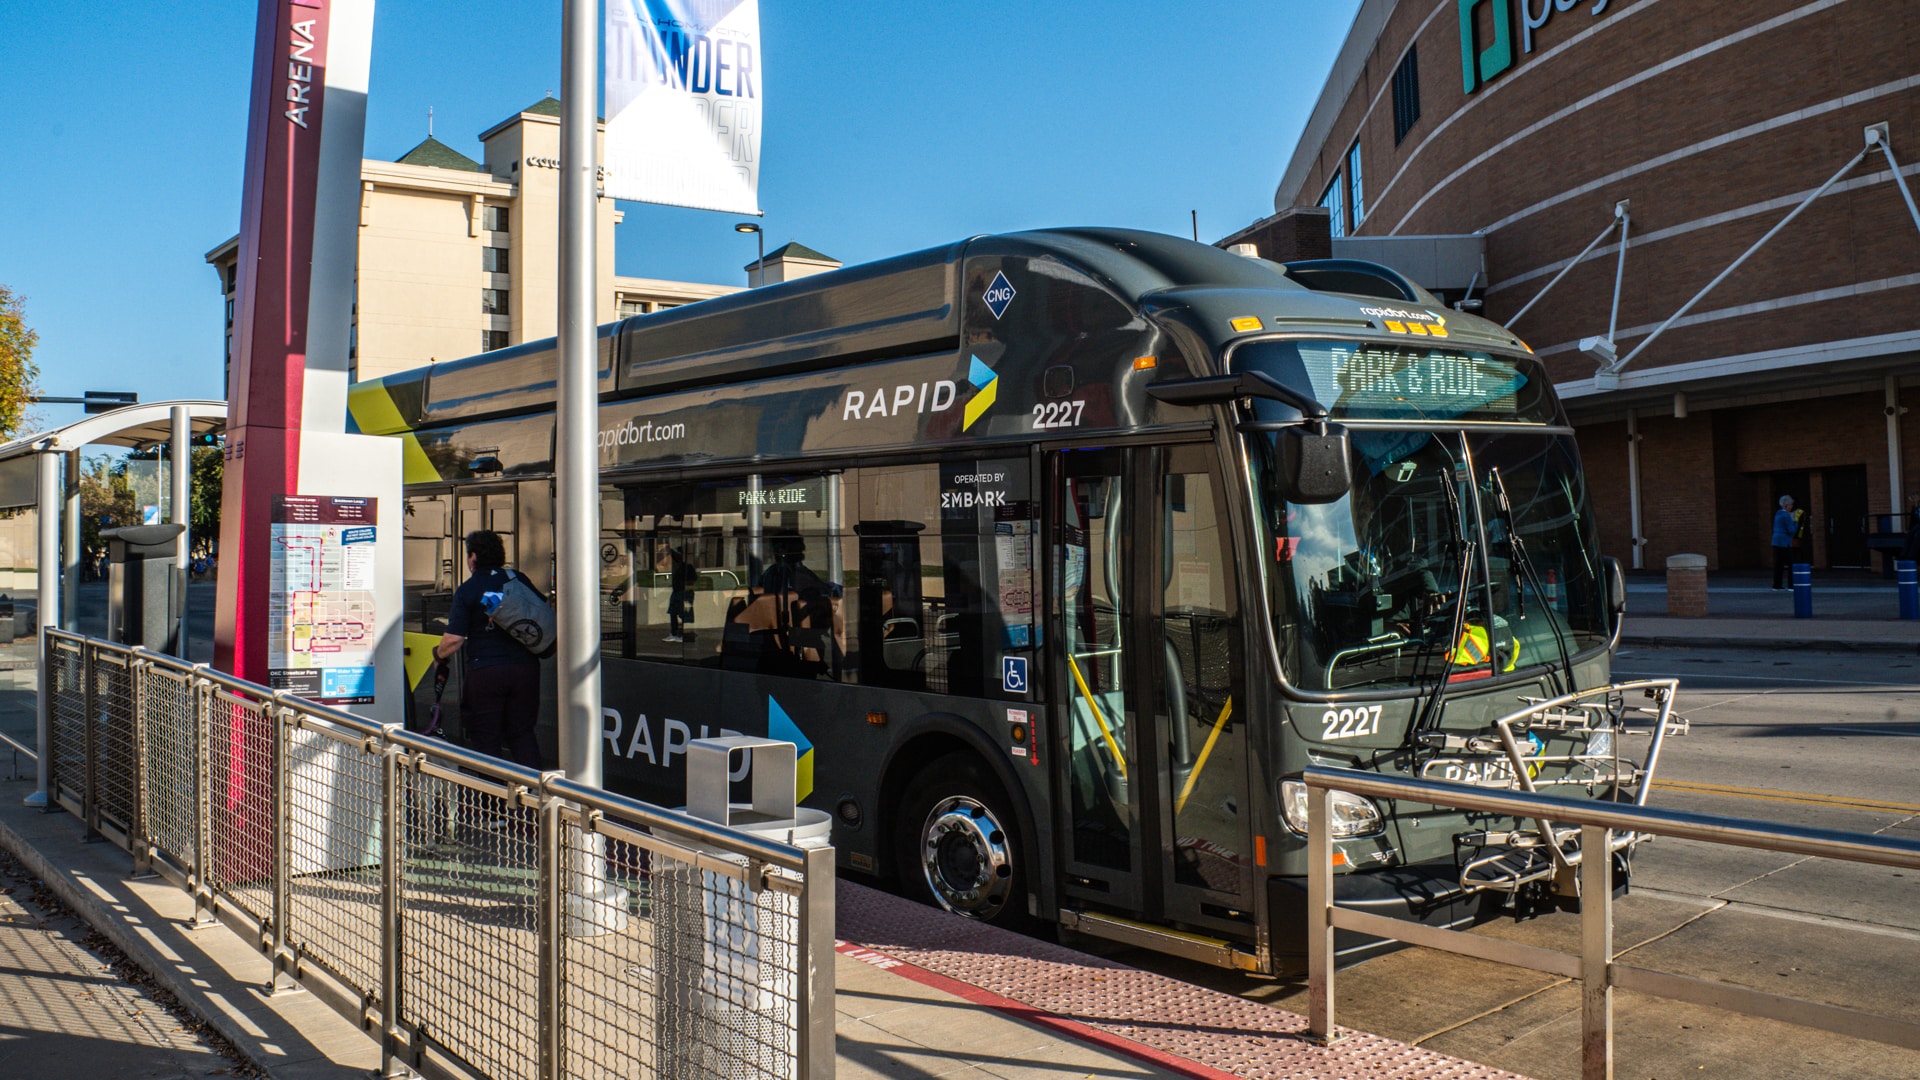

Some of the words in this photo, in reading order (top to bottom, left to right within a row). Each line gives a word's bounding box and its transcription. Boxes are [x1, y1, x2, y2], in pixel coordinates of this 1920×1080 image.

[611, 8, 712, 35] OLAHOMA
[715, 27, 752, 39] CITY
[284, 19, 316, 129] ARENA
[611, 20, 755, 99] THUNDER
[987, 287, 1010, 303] CNG
[1331, 347, 1400, 393] PARK
[1407, 353, 1424, 393] &
[1430, 354, 1487, 396] RIDE
[843, 380, 957, 421] RAPID
[1032, 400, 1086, 429] 2227
[597, 420, 685, 453] apidbrt.com
[954, 473, 993, 484] OPERATED
[994, 472, 1005, 482] BY
[738, 490, 767, 505] PARK
[769, 489, 776, 504] &
[778, 488, 807, 504] RIDE
[1322, 705, 1383, 740] 2227
